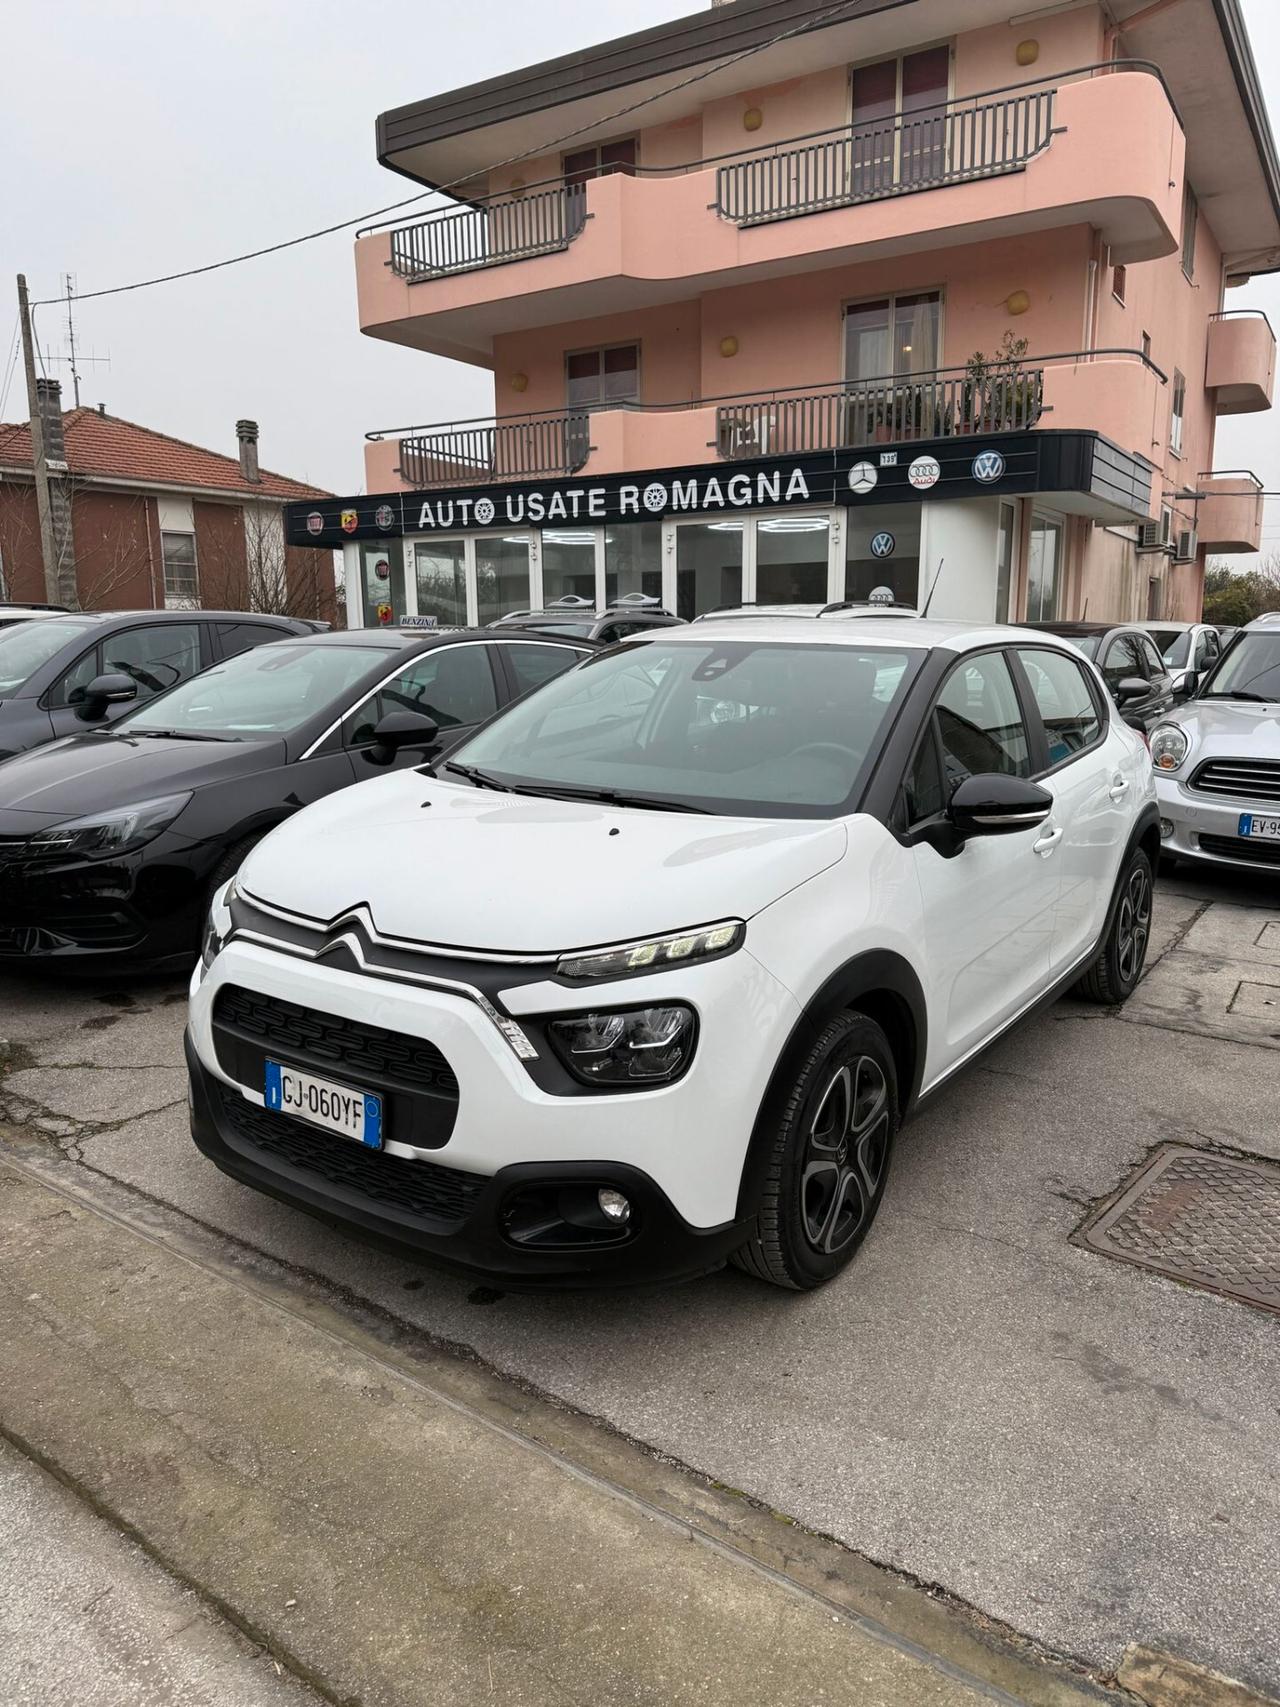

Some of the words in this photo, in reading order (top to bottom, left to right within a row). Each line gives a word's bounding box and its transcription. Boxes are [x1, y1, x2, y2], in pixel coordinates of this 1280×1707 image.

[418, 497, 495, 529] AUTO
[505, 488, 607, 523] USATE
[619, 468, 810, 515] ROMAGNA
[283, 1076, 362, 1128] GJ060YF
